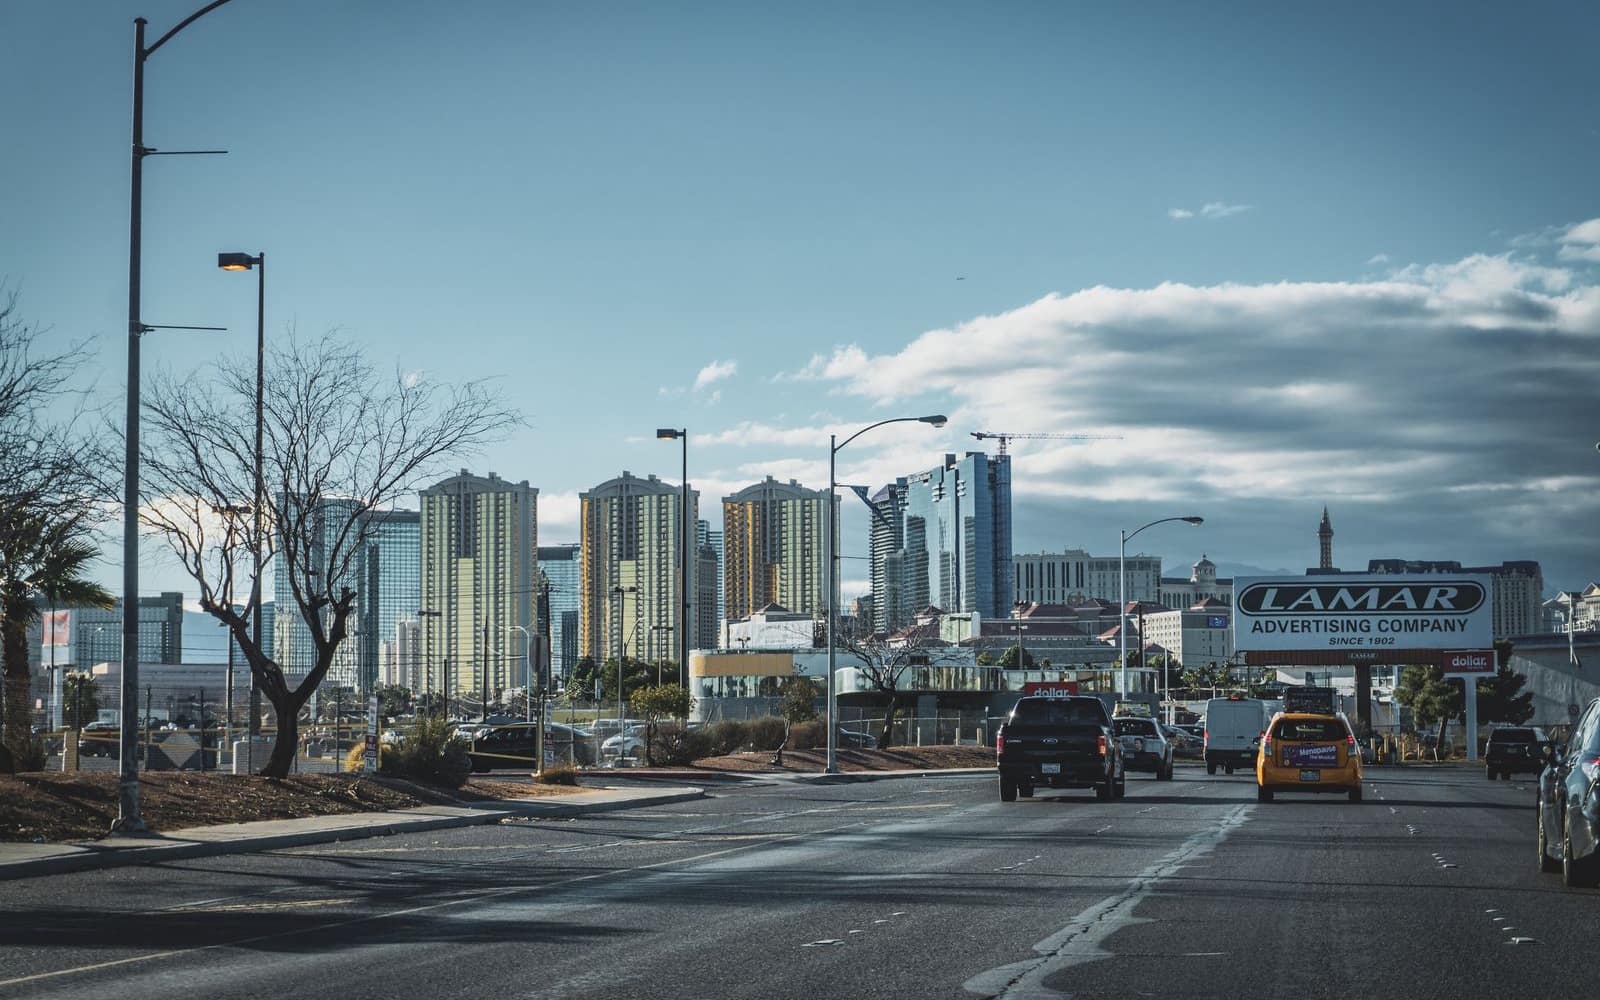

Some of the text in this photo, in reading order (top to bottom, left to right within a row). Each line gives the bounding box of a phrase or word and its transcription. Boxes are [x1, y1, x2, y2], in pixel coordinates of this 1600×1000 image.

[1260, 587, 1458, 610] LAMAR
[1251, 618, 1469, 633] ADVERTISING COMPANY
[1328, 637, 1395, 646] SINCE 1902
[1299, 745, 1336, 756] Menopause
